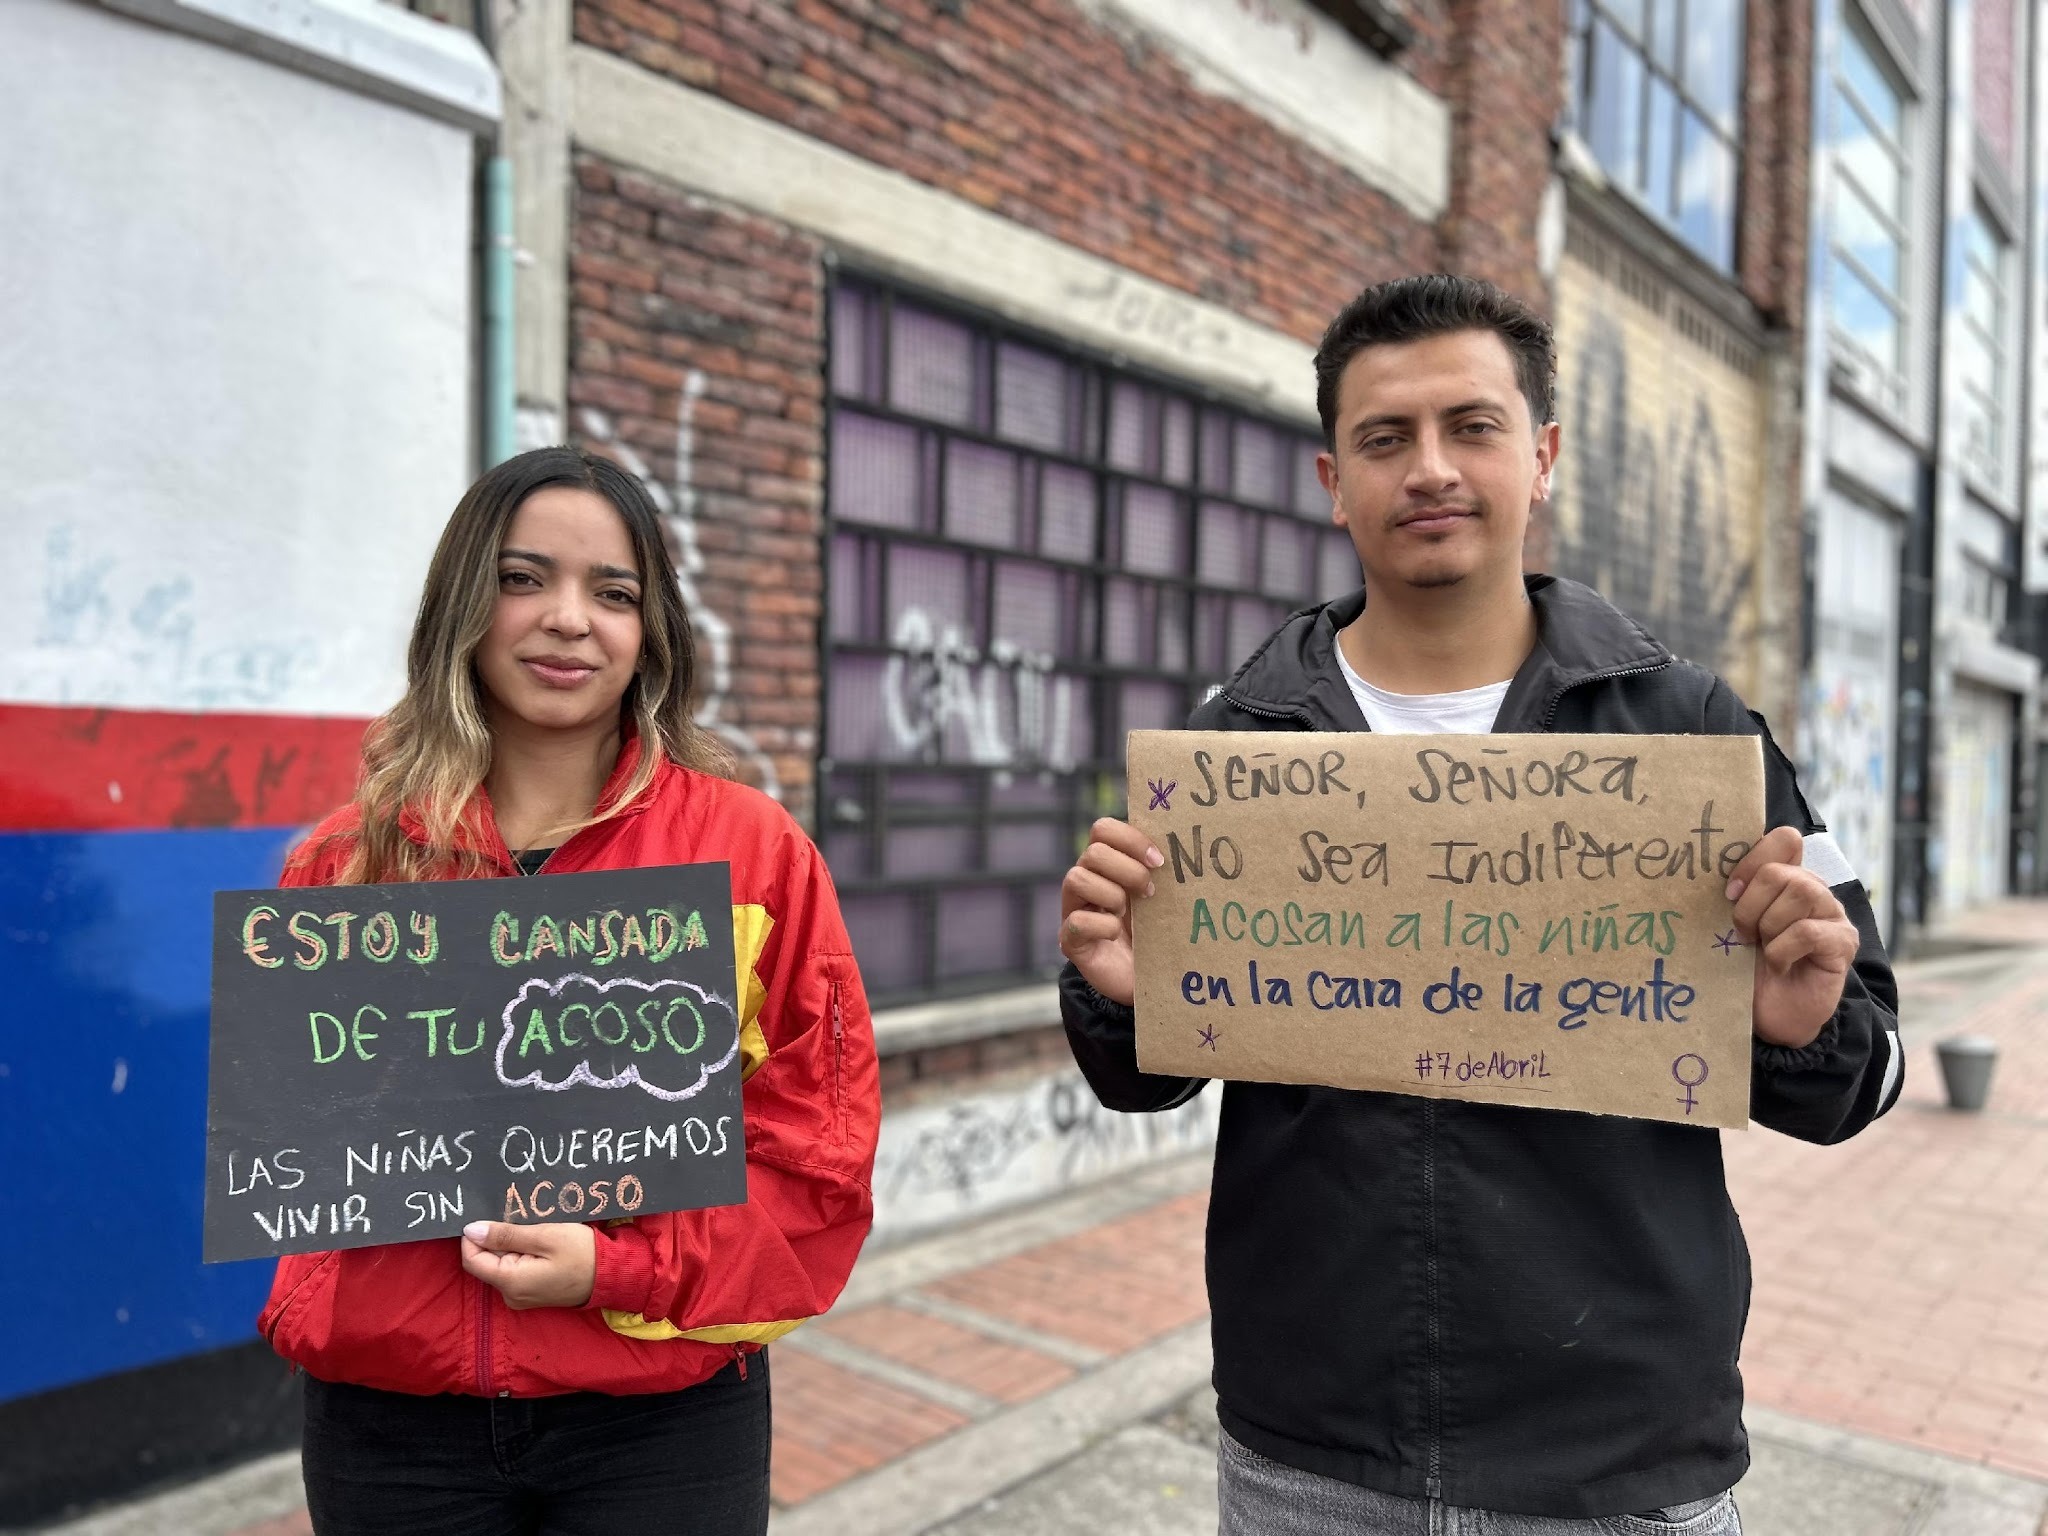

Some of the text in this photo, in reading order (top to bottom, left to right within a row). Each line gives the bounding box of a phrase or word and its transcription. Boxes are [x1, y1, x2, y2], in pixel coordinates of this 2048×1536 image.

[242, 906, 709, 971] ESTOY CANSADA
[1385, 912, 1421, 951] a
[1443, 899, 1519, 957] las
[1538, 903, 1683, 956] niñas
[1181, 970, 1236, 1007] en
[1248, 960, 1293, 1007] la
[1422, 966, 1483, 1014] de
[1504, 973, 1543, 1013] la
[1557, 957, 1696, 1030] gente
[309, 996, 707, 1064] DE TU ACOSO
[228, 1115, 732, 1196] LAS NIÑAS QUEREMOS
[252, 1174, 644, 1242] VIVIR SIN ACOSO
